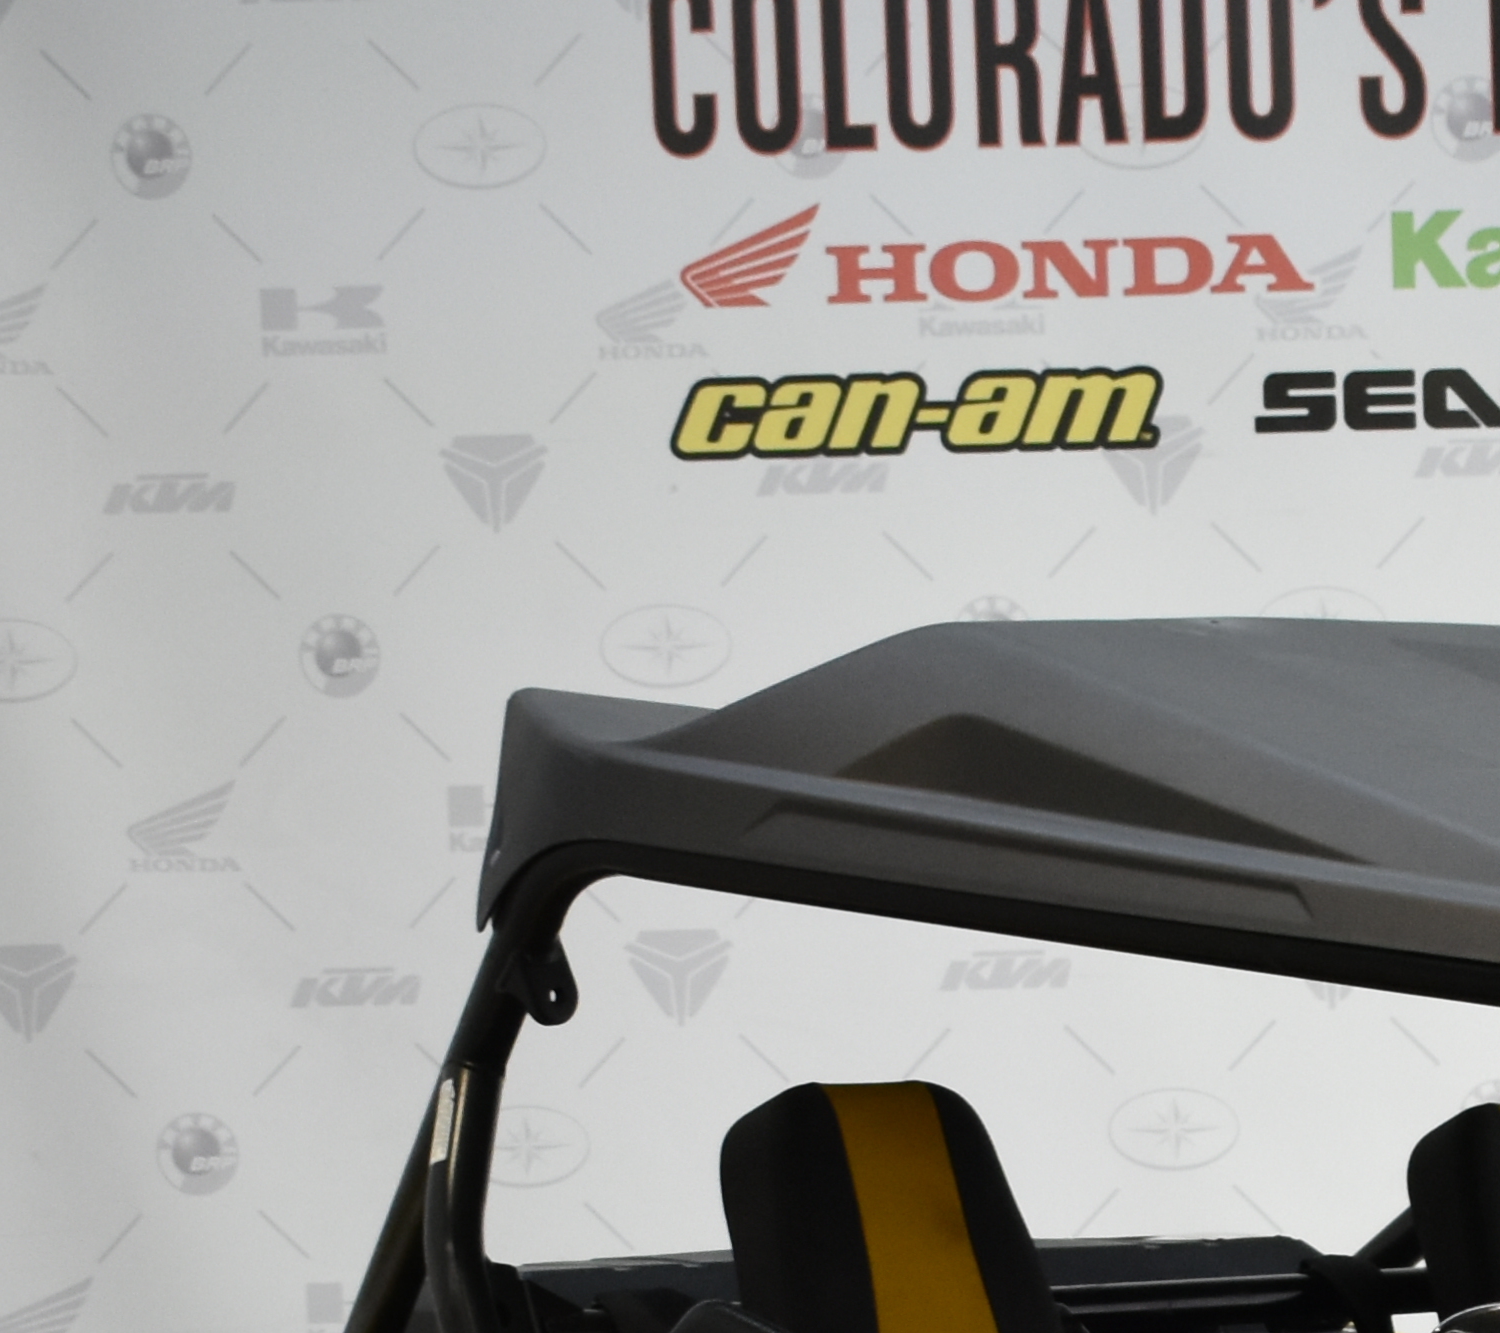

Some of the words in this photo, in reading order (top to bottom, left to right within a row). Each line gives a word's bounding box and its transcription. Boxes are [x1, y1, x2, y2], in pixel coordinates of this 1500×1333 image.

[648, 0, 1430, 159] COLORADOS
[143, 157, 193, 174] BRP
[824, 232, 1316, 305] HONDA
[918, 312, 1045, 338] Kawasaki
[1255, 322, 1368, 342] HONDA
[259, 333, 387, 358] Kawasaki
[597, 342, 709, 361] HONDA
[670, 367, 1162, 461] can-am
[757, 459, 890, 497] KTM
[103, 472, 235, 515] KTM
[332, 656, 382, 673] BRP
[129, 856, 242, 873] HONDA
[939, 950, 1070, 993] KTM
[290, 967, 420, 1009] KTM
[186, 1155, 236, 1172] BRP
